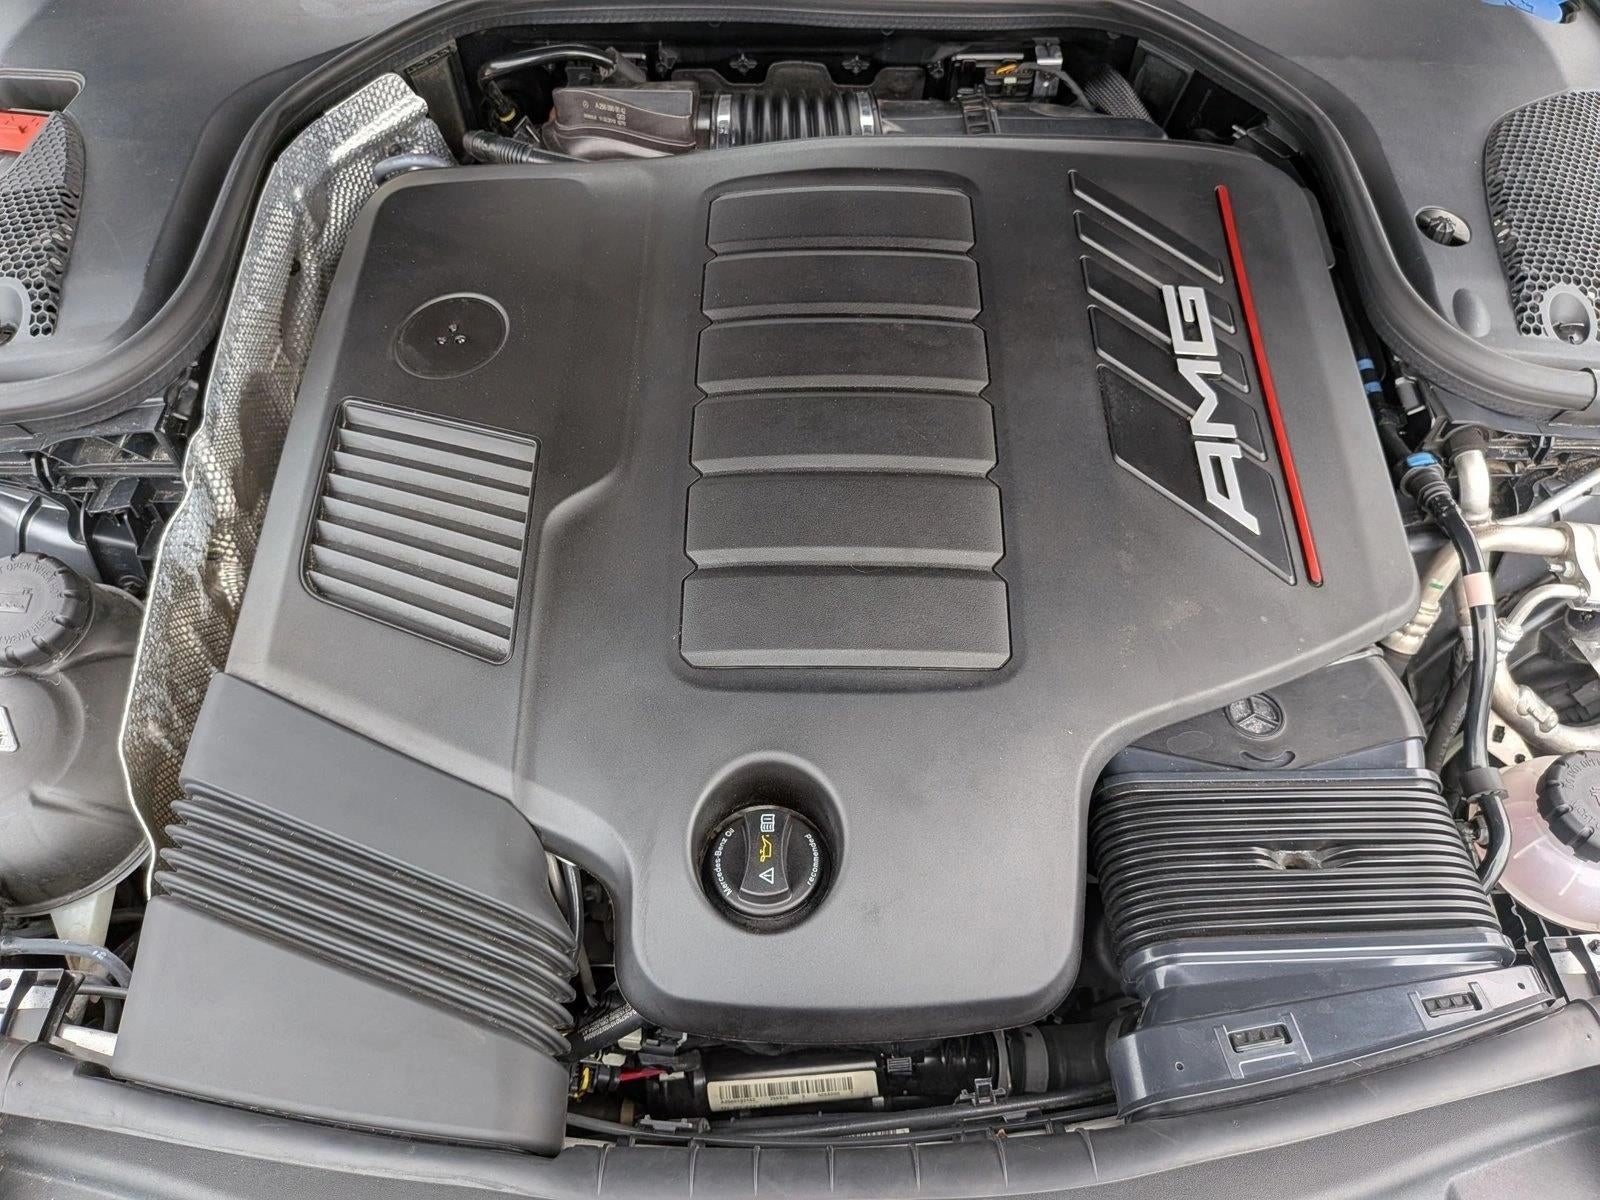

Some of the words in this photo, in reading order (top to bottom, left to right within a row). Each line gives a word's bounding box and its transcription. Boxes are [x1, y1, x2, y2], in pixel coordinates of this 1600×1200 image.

[1162, 285, 1261, 535] AMG
[7, 562, 31, 572] OPEN
[32, 565, 57, 583] WHEN
[4, 629, 31, 644] WENN
[714, 837, 733, 897] Mercedes-Benz
[725, 827, 735, 837] Oil
[804, 833, 820, 886] recommended
